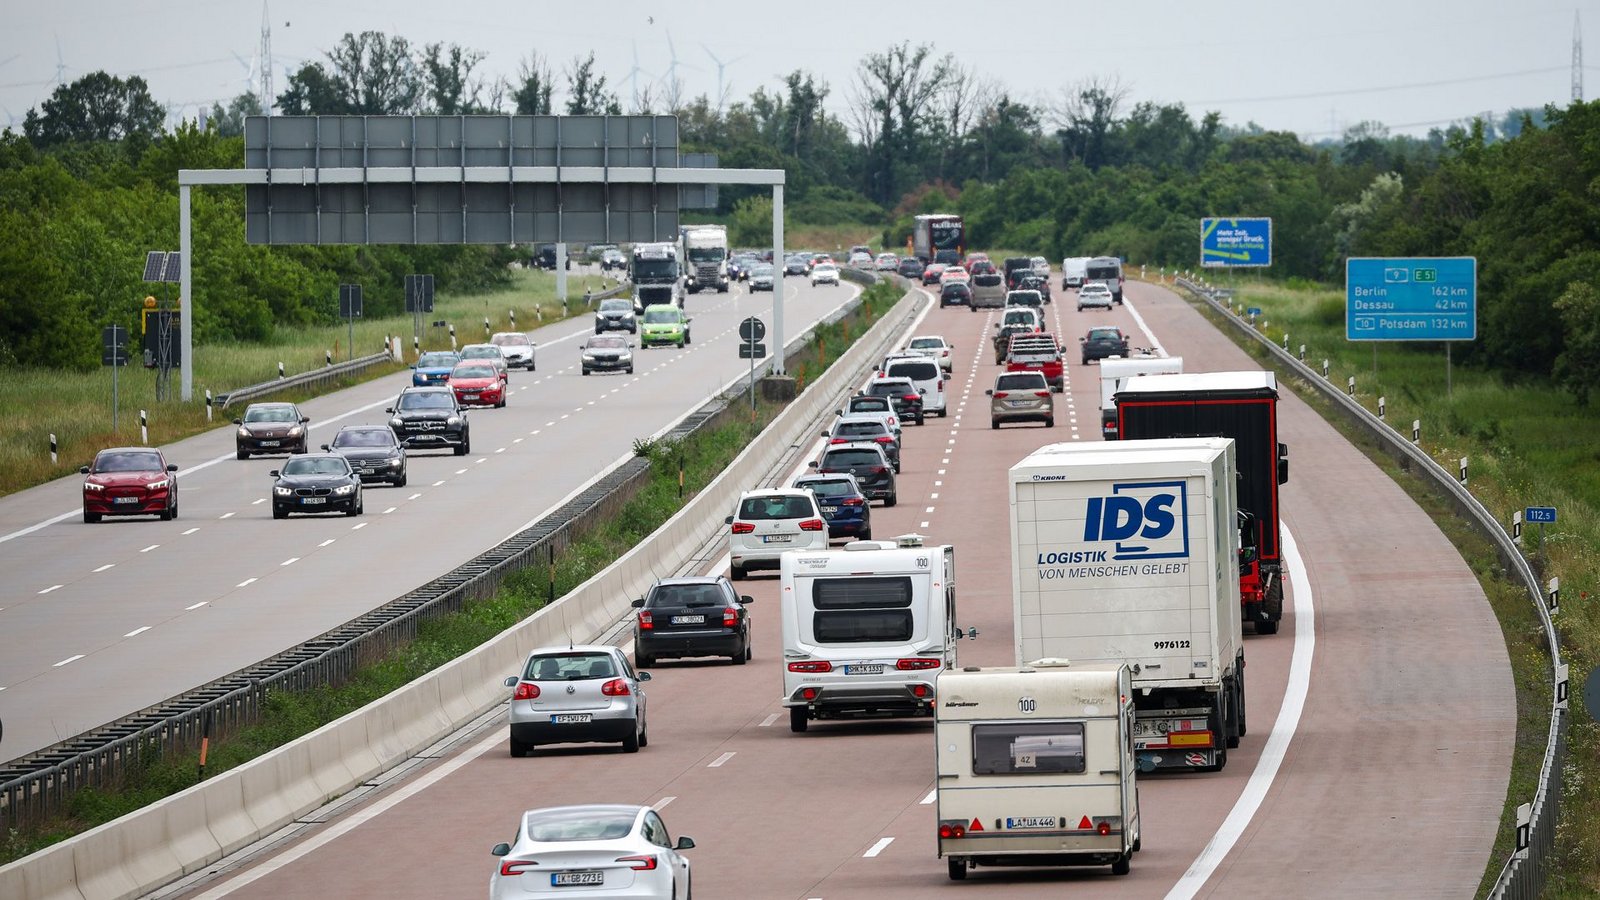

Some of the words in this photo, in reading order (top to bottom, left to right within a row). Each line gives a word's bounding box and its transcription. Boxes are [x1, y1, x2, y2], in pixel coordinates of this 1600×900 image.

[1393, 270, 1400, 280] 9
[1415, 270, 1422, 280] E
[1424, 270, 1435, 280] 51
[1354, 286, 1387, 296] Berlin
[1431, 286, 1448, 296] 162
[1450, 286, 1467, 296] km
[1354, 300, 1394, 310] Dessau
[1435, 300, 1448, 309] 42
[1450, 300, 1467, 309] km
[1361, 320, 1369, 328] 10
[1379, 319, 1426, 329] Potsdam
[1431, 319, 1448, 329] 132
[1450, 319, 1467, 329] km
[1083, 493, 1176, 542] IDS
[916, 558, 928, 567] 100
[1037, 550, 1107, 565] LOGISTIK
[1038, 568, 1065, 580] VON
[1068, 565, 1138, 578] MENSCHEN
[1139, 562, 1189, 575] GELEBT
[1153, 640, 1190, 649] 9976122
[1019, 699, 1035, 712] 100
[1011, 819, 1022, 827] LA
[1039, 818, 1053, 826] 446
